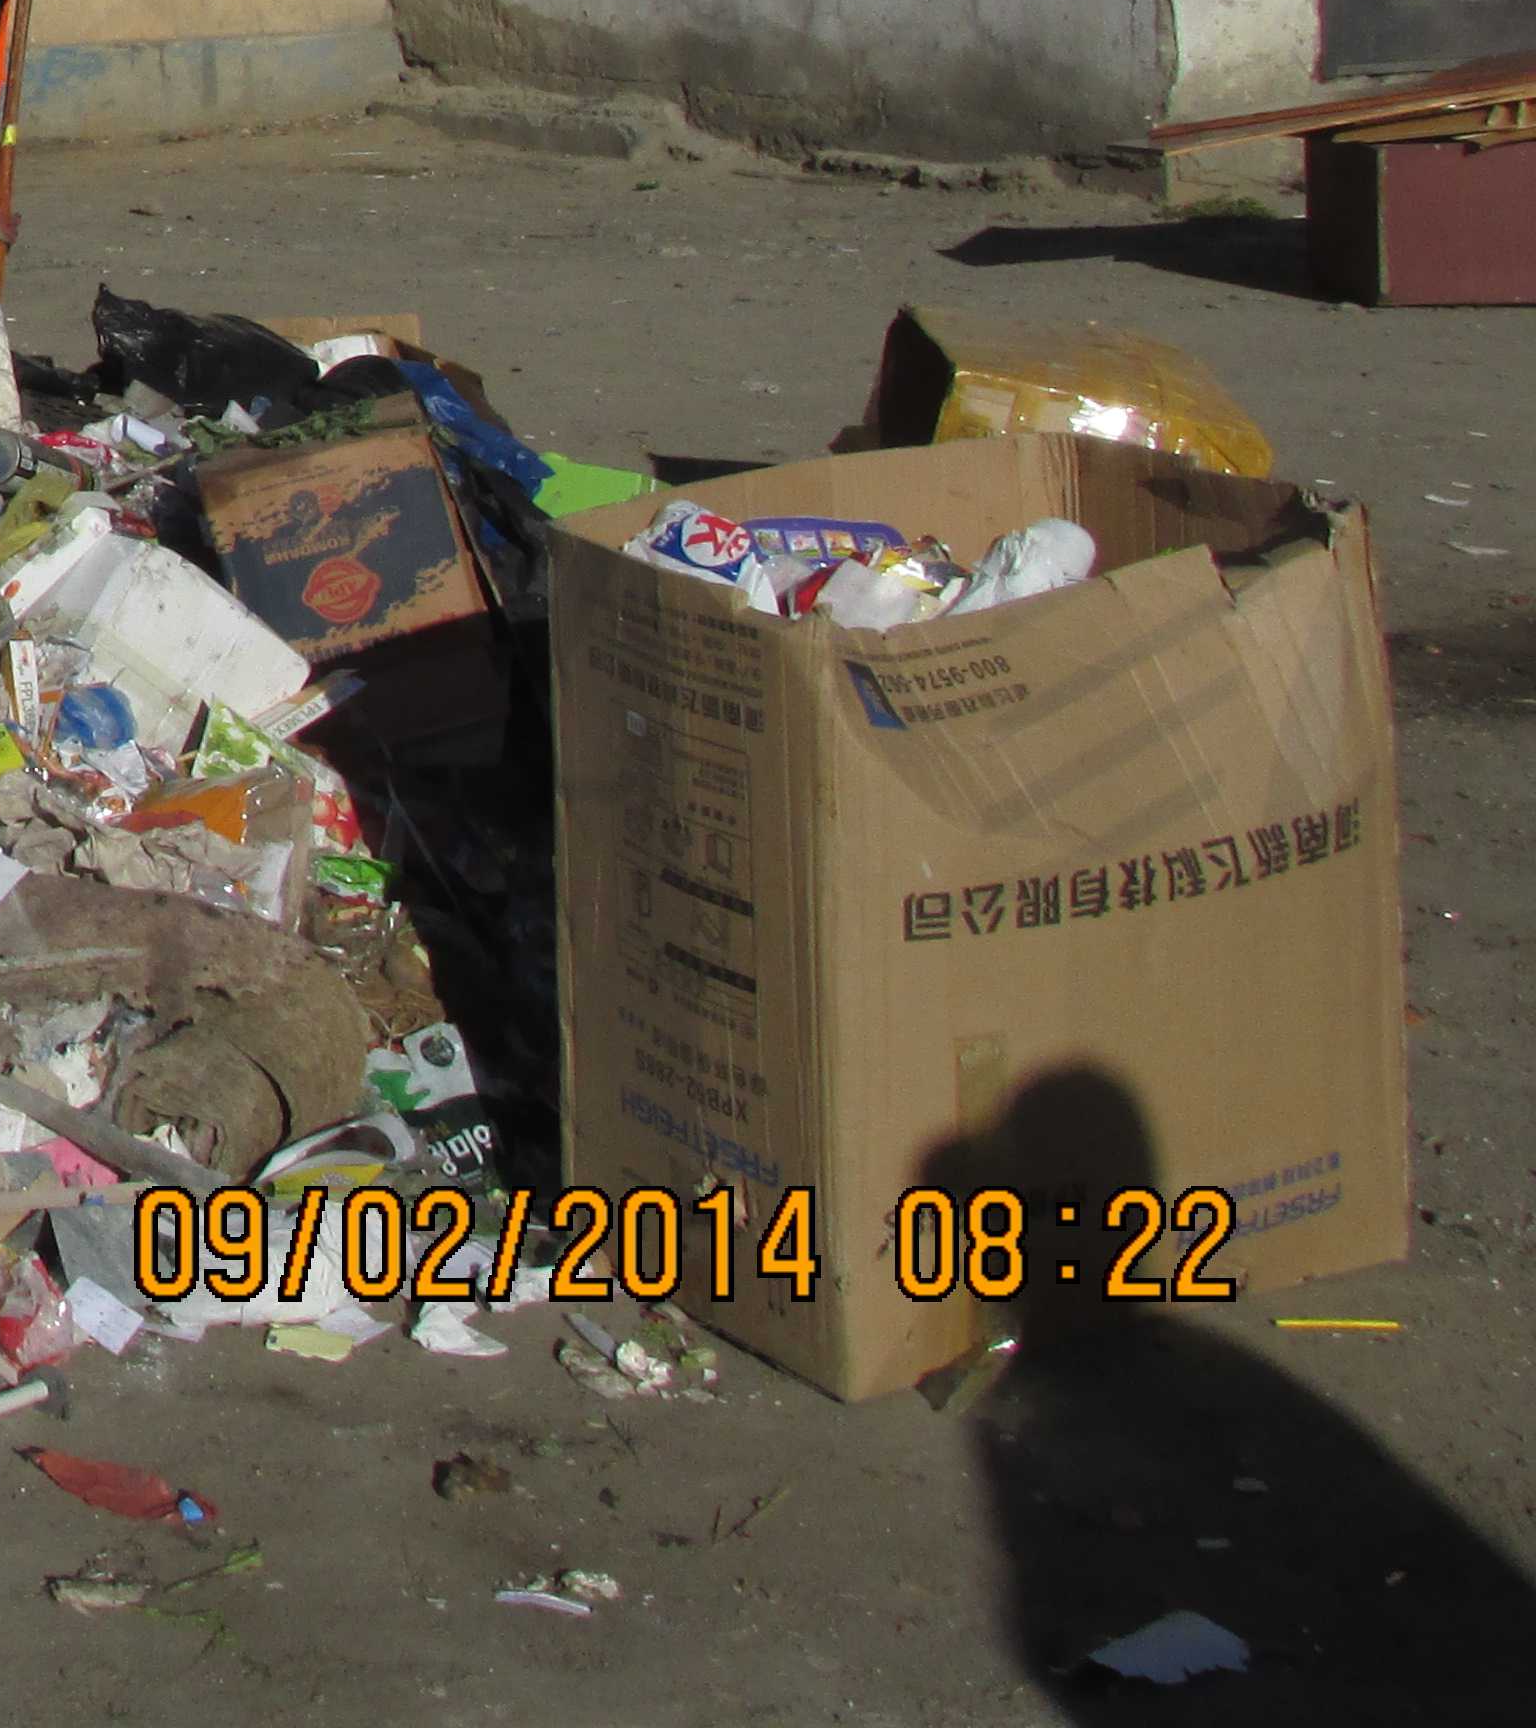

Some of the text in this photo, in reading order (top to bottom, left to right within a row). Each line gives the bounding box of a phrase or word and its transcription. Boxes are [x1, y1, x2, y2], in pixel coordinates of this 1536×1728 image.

[902, 797, 1361, 942] 河南新飞科技有限公司
